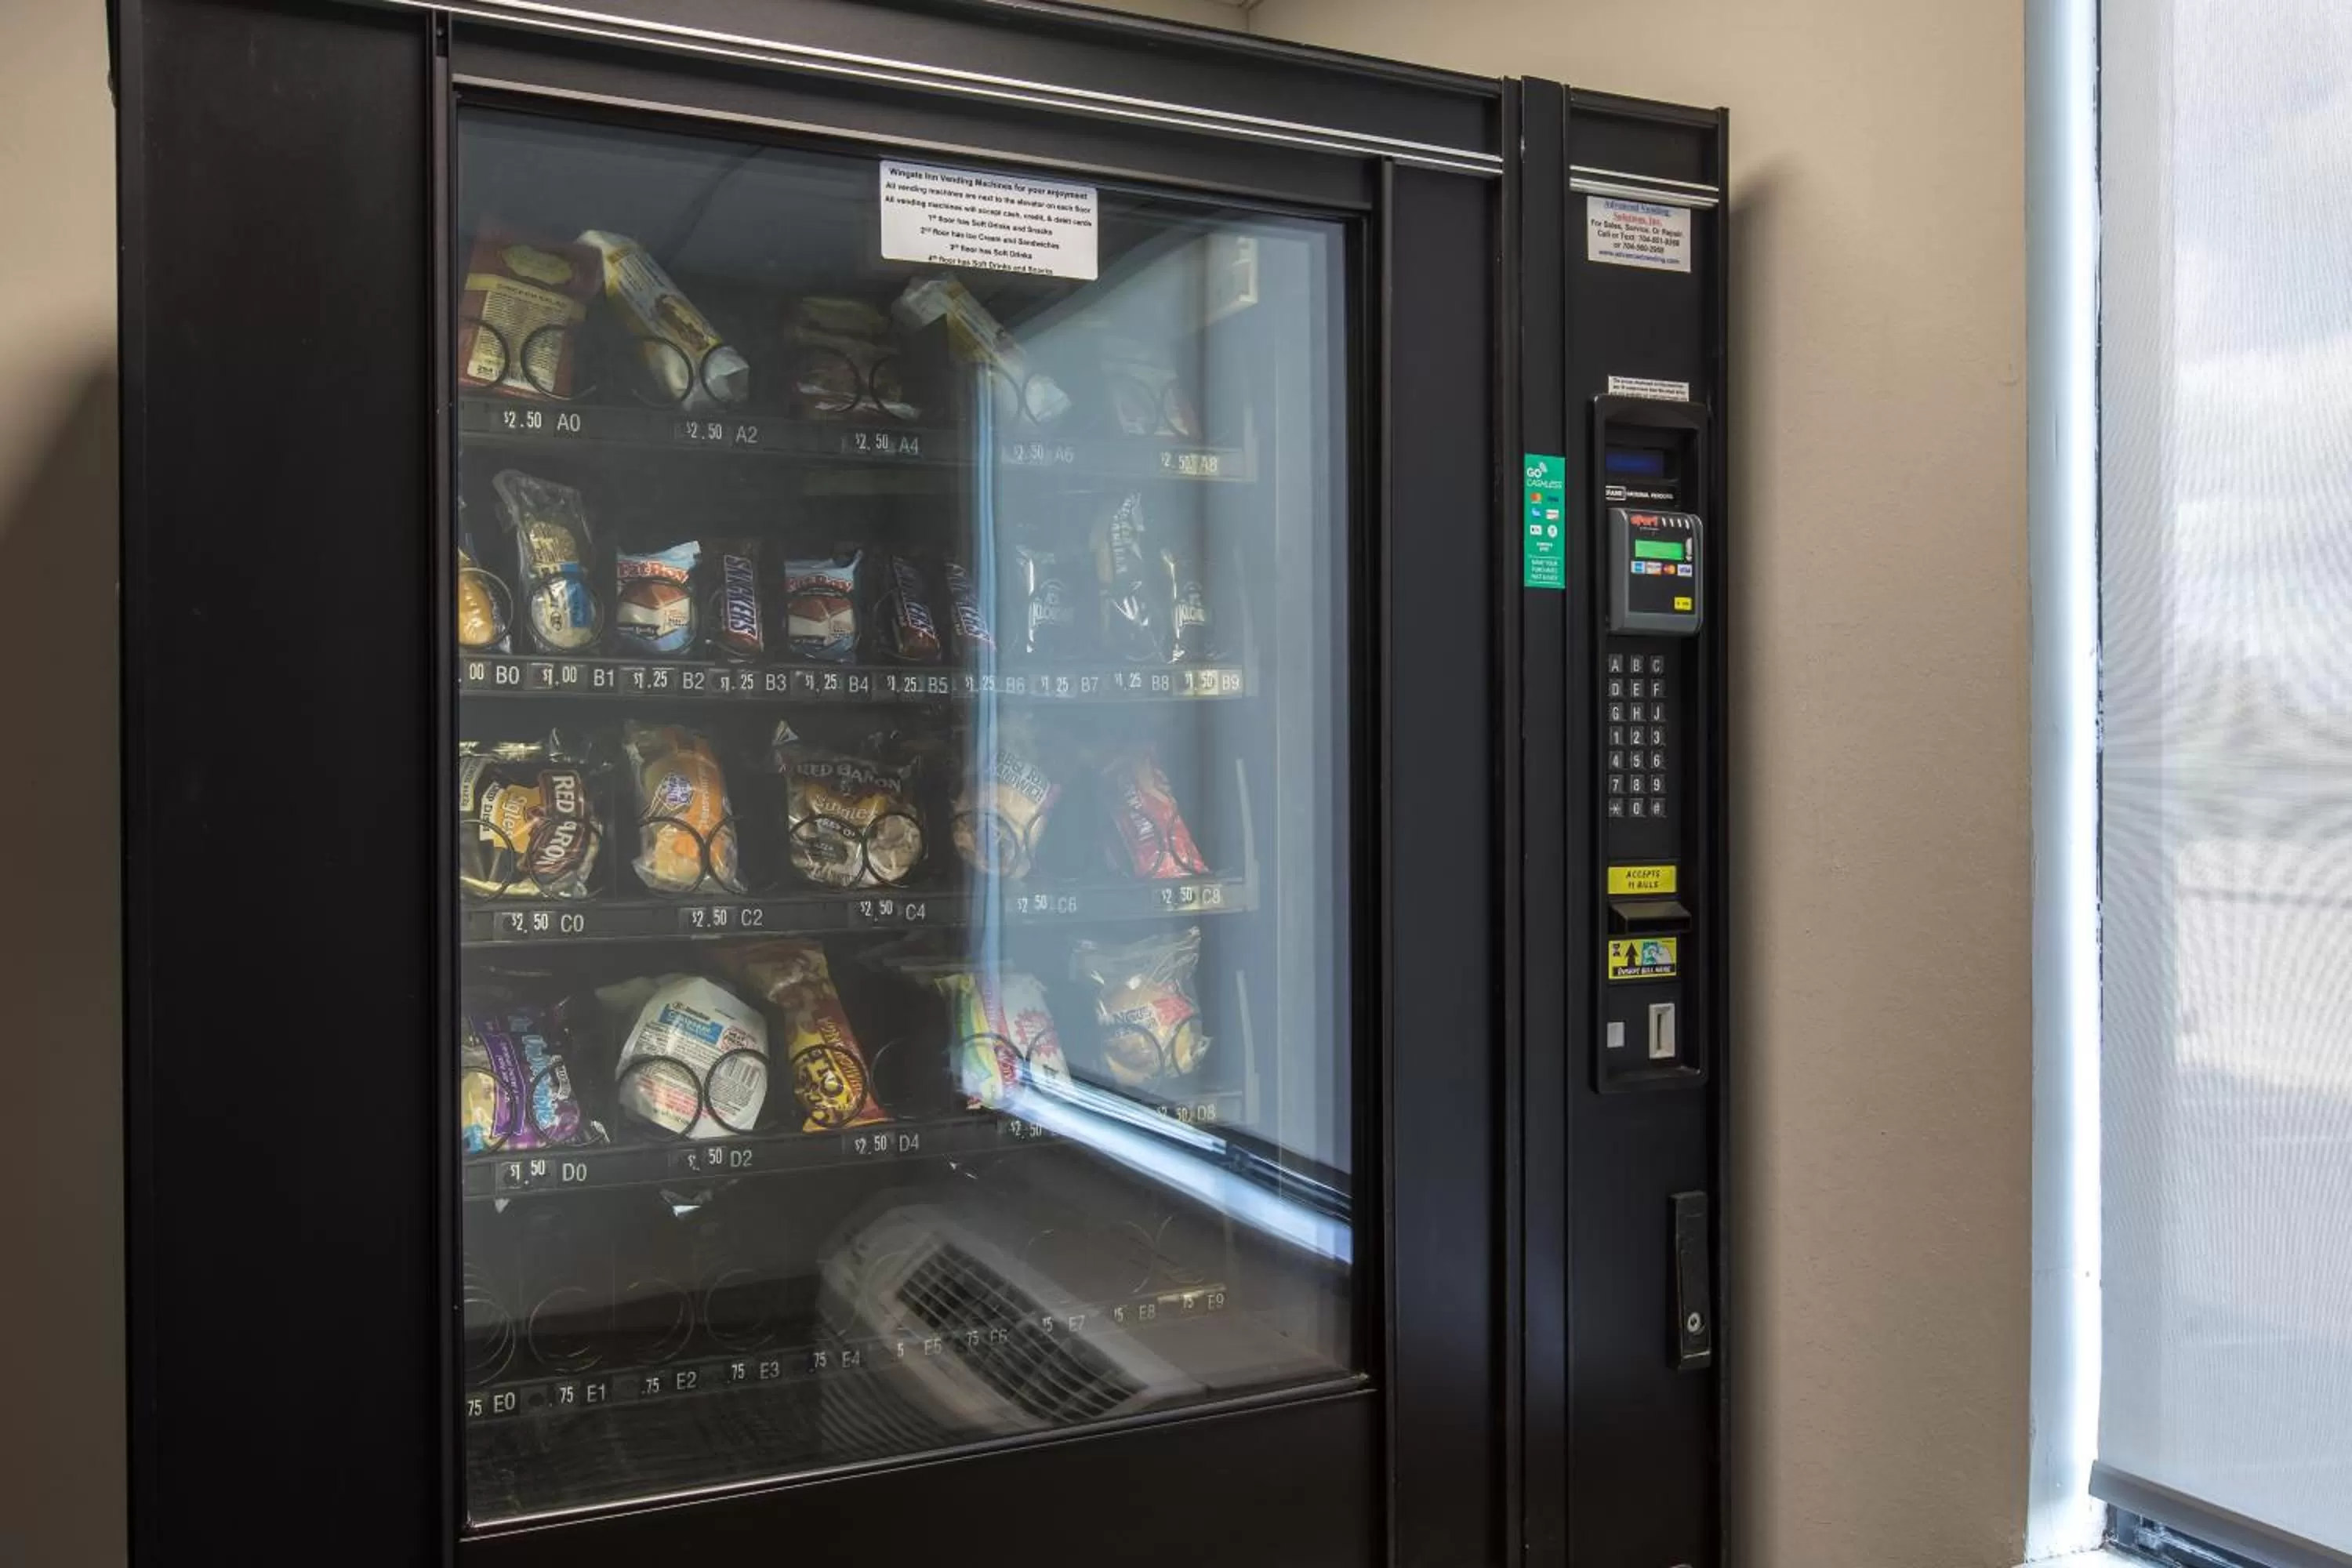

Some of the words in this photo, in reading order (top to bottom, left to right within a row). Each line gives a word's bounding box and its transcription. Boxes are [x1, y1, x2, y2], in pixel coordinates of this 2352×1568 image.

[889, 168, 923, 180] Wingate
[941, 175, 973, 187] Vending
[975, 179, 1012, 191] Machines
[1014, 183, 1025, 192] for
[1028, 187, 1045, 195] your
[1047, 189, 1087, 200] enjoyment
[897, 198, 926, 209] vending
[927, 201, 963, 211] machines
[898, 184, 927, 194] vending
[928, 187, 963, 198] machines
[1017, 198, 1044, 208] elevator
[1004, 236, 1016, 245] and
[1018, 238, 1059, 249] Sandwiches
[504, 411, 542, 428] $2.50
[557, 413, 580, 432] A0
[687, 421, 722, 440] $2.50
[735, 426, 758, 444] A2
[899, 437, 918, 455] A4
[1611, 658, 1619, 672] A
[1633, 658, 1639, 672] B
[1653, 659, 1660, 672] C
[496, 665, 519, 684] B0
[593, 668, 615, 687] B1
[683, 672, 705, 690] B2
[766, 673, 787, 691] B3
[849, 674, 868, 692] B4
[1152, 674, 1169, 691] B8
[927, 677, 949, 694] B5
[1081, 677, 1098, 693] B7
[1612, 683, 1619, 696] D
[1633, 683, 1640, 696] E
[1653, 683, 1660, 696] F
[1613, 706, 1619, 720] G
[1633, 707, 1640, 720] H
[1653, 706, 1661, 720] J
[1613, 731, 1619, 744] 1
[1633, 731, 1640, 744] 2
[1653, 731, 1660, 744] 3
[1613, 754, 1619, 768] 4
[1633, 754, 1640, 768] 5
[1653, 753, 1660, 768] 6
[1613, 779, 1619, 791] 7
[1633, 779, 1639, 791] 8
[1653, 779, 1660, 791] 9
[551, 775, 575, 814] RED
[1633, 802, 1639, 815] 0
[1626, 869, 1661, 879] ACCEPTS
[692, 909, 727, 927] $2.50
[741, 909, 763, 927] C2
[906, 904, 926, 921] C4
[511, 913, 548, 934] $2.50
[561, 915, 584, 933] C0
[899, 1133, 919, 1152] D4
[730, 1149, 752, 1168] D2
[562, 1163, 586, 1182] D0
[1139, 1304, 1155, 1321] E8
[1069, 1315, 1085, 1332] E7
[924, 1338, 942, 1356] E5
[841, 1350, 859, 1368] E4
[760, 1361, 780, 1380] E3
[677, 1371, 697, 1391] E2
[587, 1384, 604, 1403] E1
[494, 1392, 515, 1414] E0
